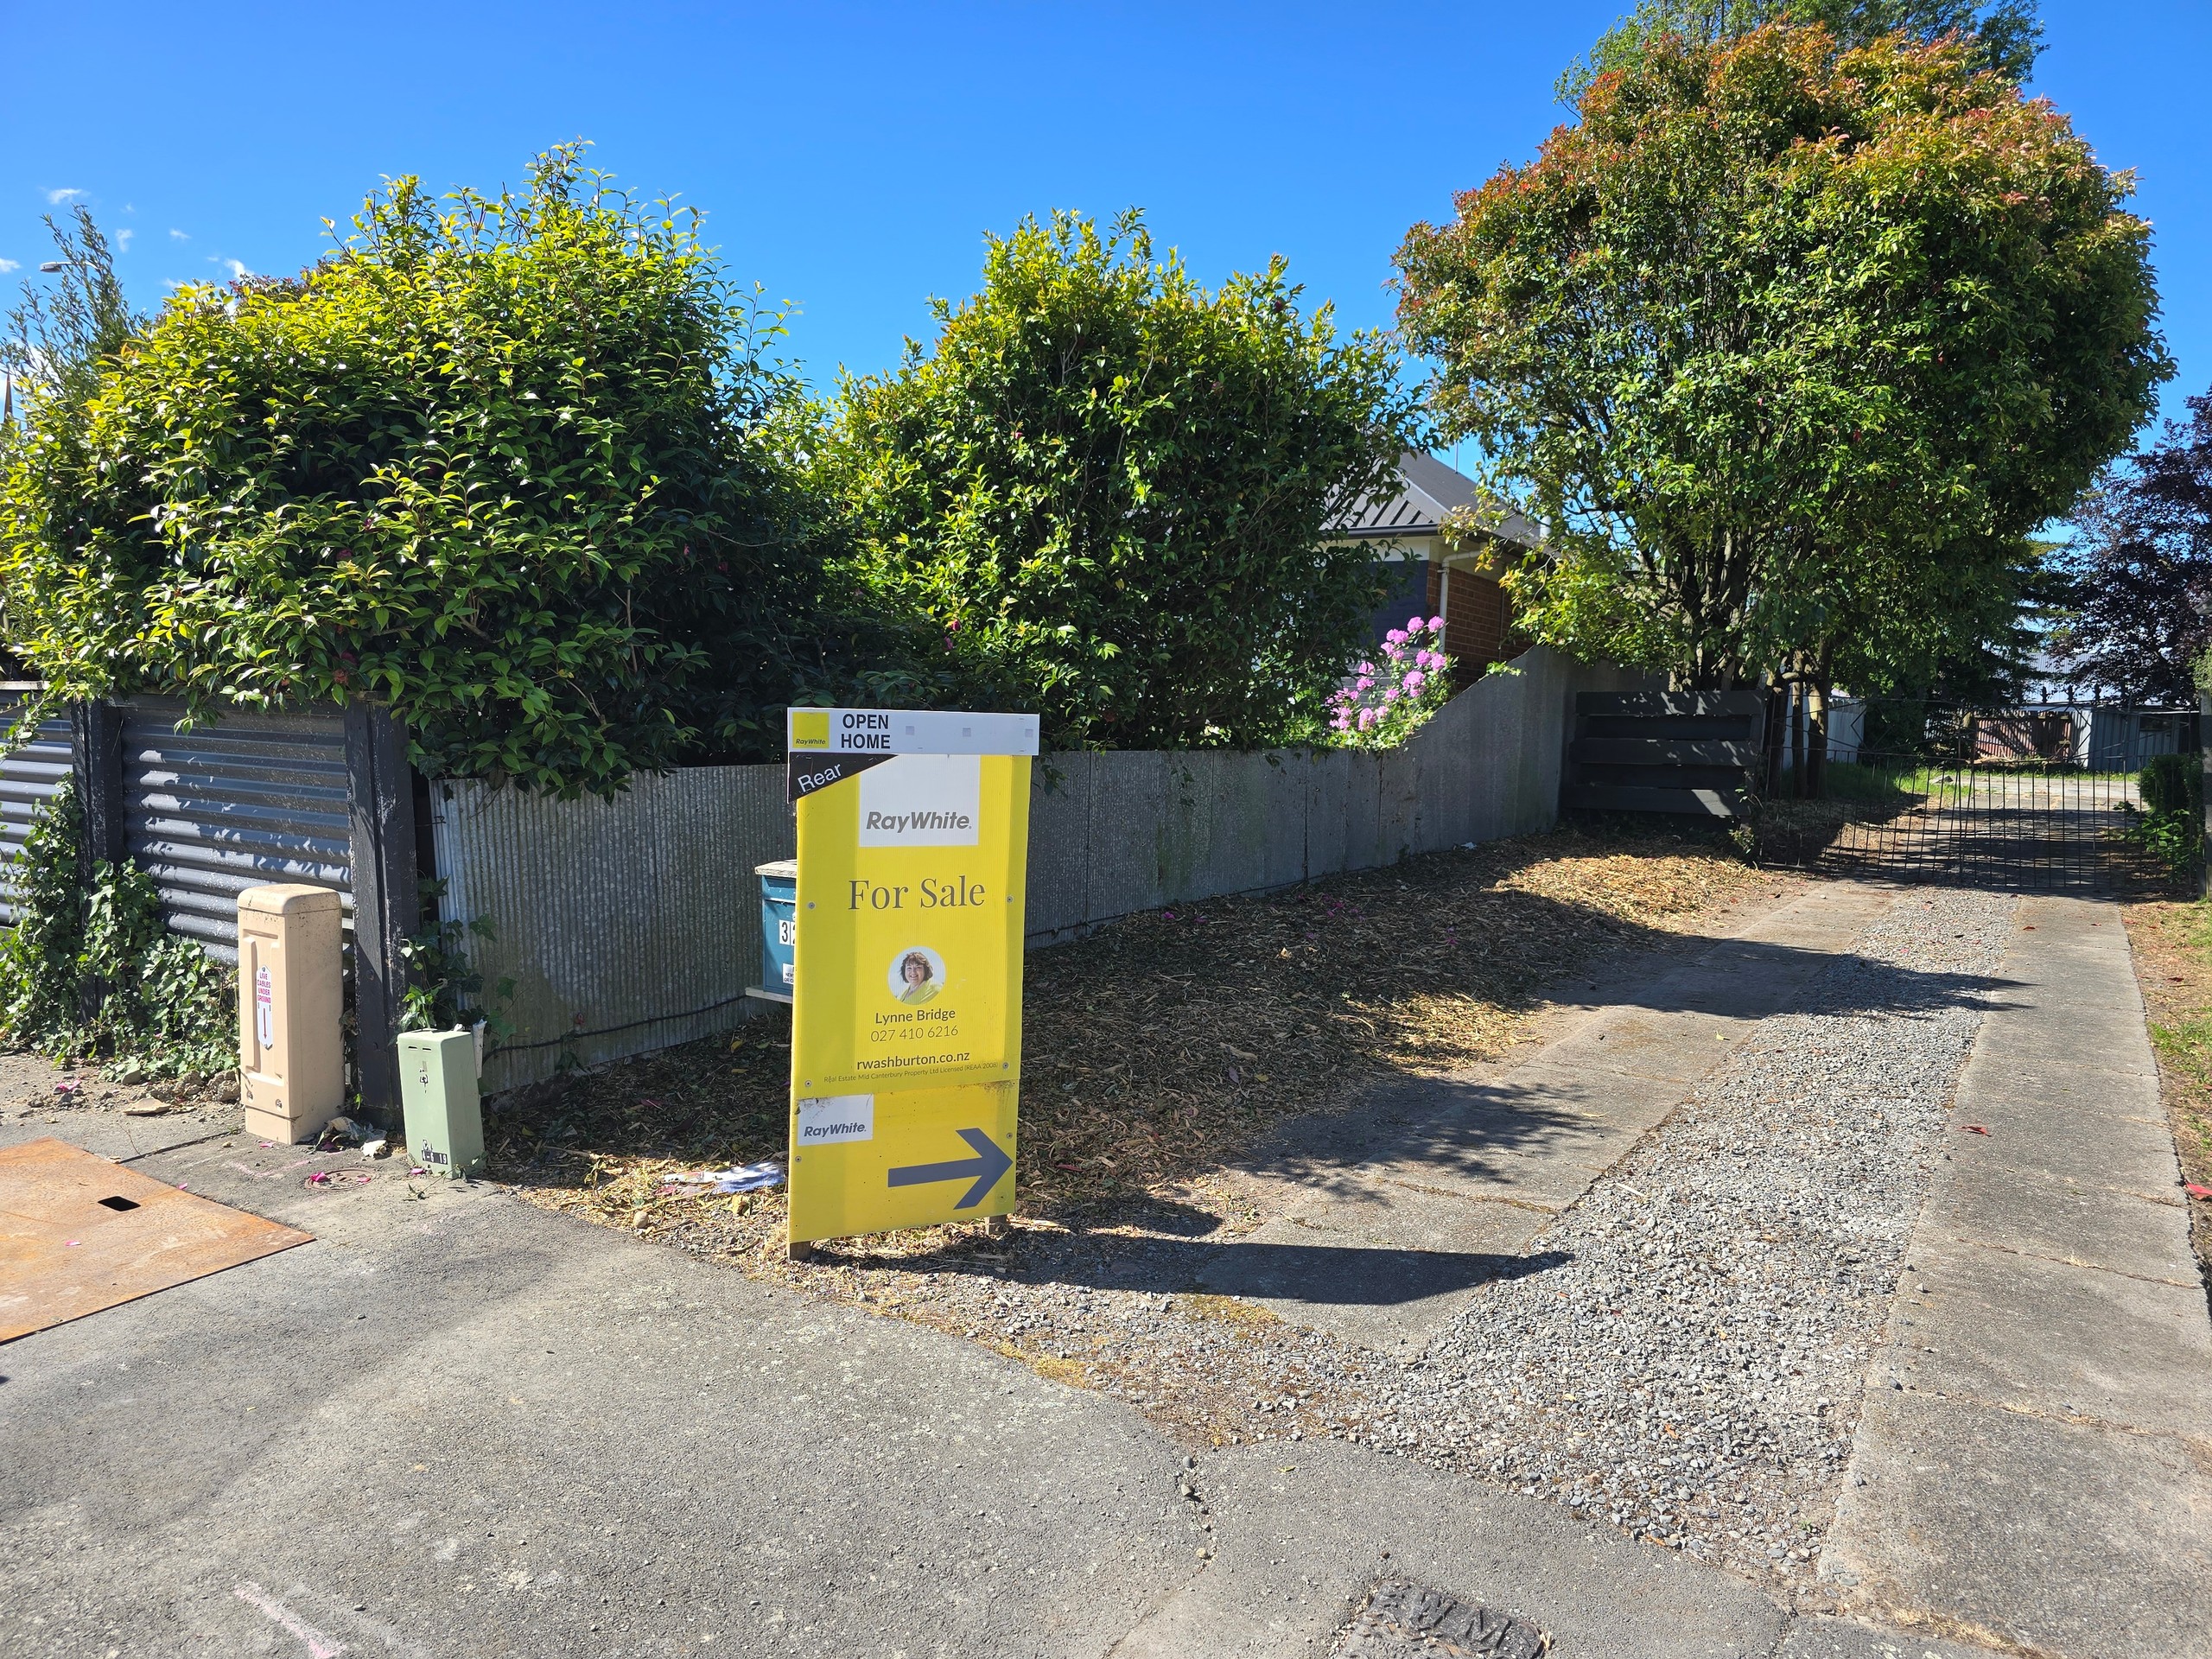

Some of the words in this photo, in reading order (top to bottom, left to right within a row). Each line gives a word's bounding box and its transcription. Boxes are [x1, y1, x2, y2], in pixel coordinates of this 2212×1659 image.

[842, 714, 889, 729] OPEN
[841, 734, 891, 749] HOME
[798, 764, 842, 792] Rear
[848, 880, 909, 910] For
[920, 874, 986, 908] Sale
[257, 995, 270, 1003] GROUND
[875, 1012, 913, 1026] Lynne
[917, 1008, 956, 1022] Bridge
[870, 1029, 896, 1042] 027
[899, 1027, 924, 1039] 410
[927, 1025, 958, 1039] 6216
[857, 1052, 970, 1070] rwashburton.co.nz
[824, 1075, 837, 1084] Real
[871, 1070, 903, 1079] Canterbury
[904, 1068, 929, 1077] Property
[940, 1065, 963, 1073] Licensed
[964, 1062, 982, 1071] (REAA
